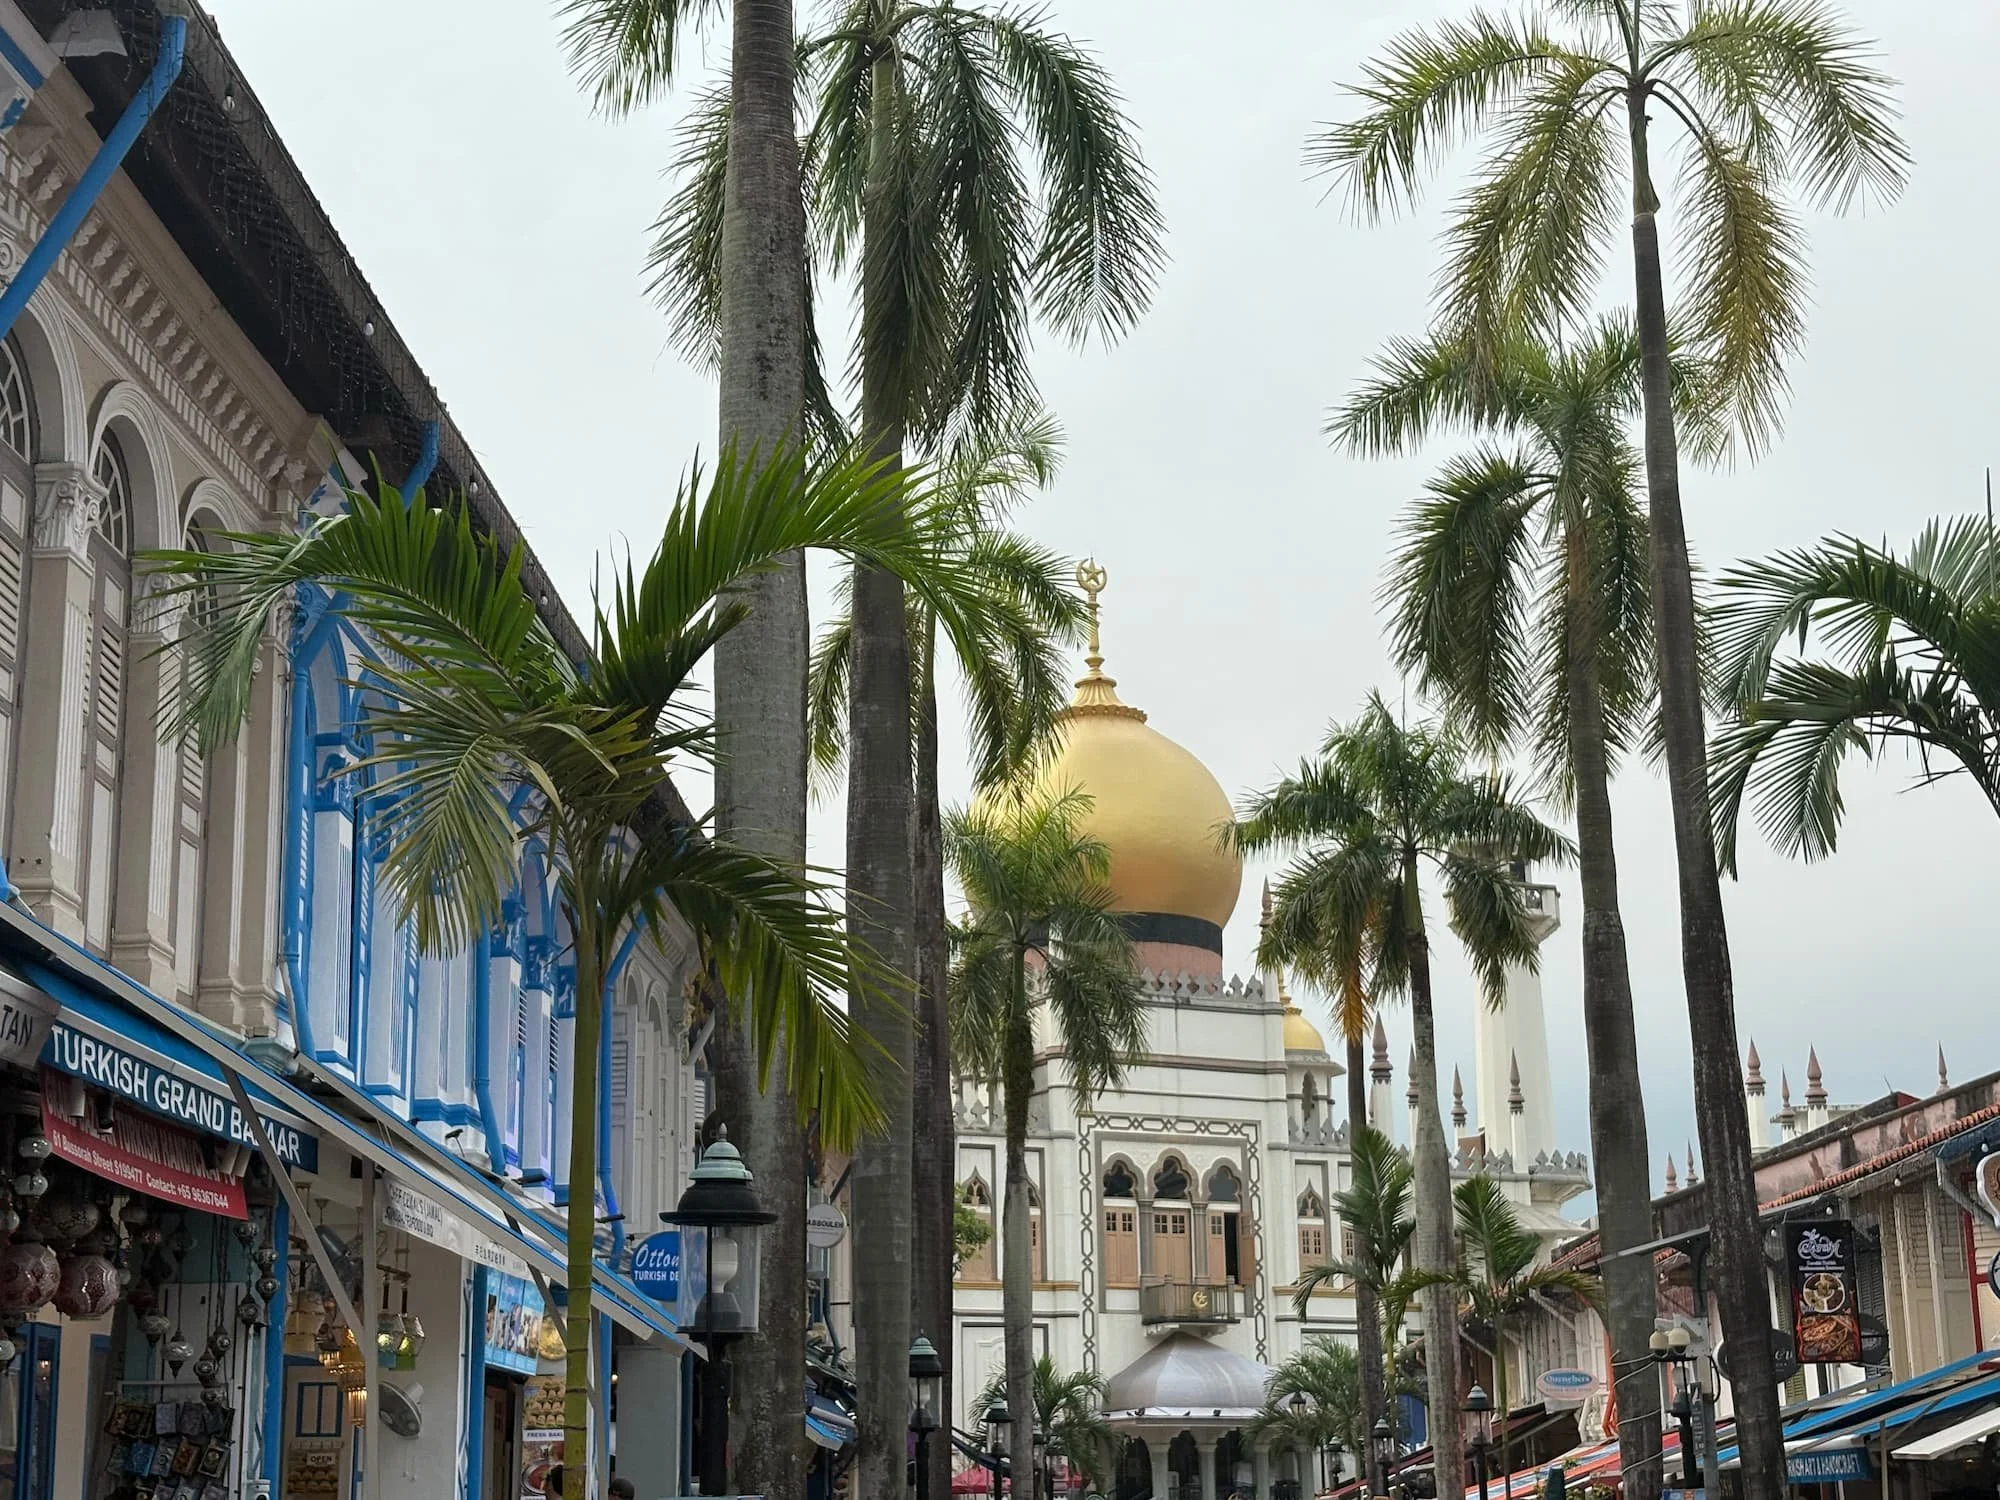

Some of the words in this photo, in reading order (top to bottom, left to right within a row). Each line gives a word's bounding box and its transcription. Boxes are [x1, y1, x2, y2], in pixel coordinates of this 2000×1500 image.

[0, 1004, 33, 1047] TAN
[51, 1024, 149, 1103] TURKISH
[154, 1075, 225, 1132] GRAND
[92, 1150, 114, 1175] Street
[807, 1219, 844, 1229] BBOULEH
[634, 1270, 667, 1281] TURKISH
[310, 1455, 332, 1464] OPEN
